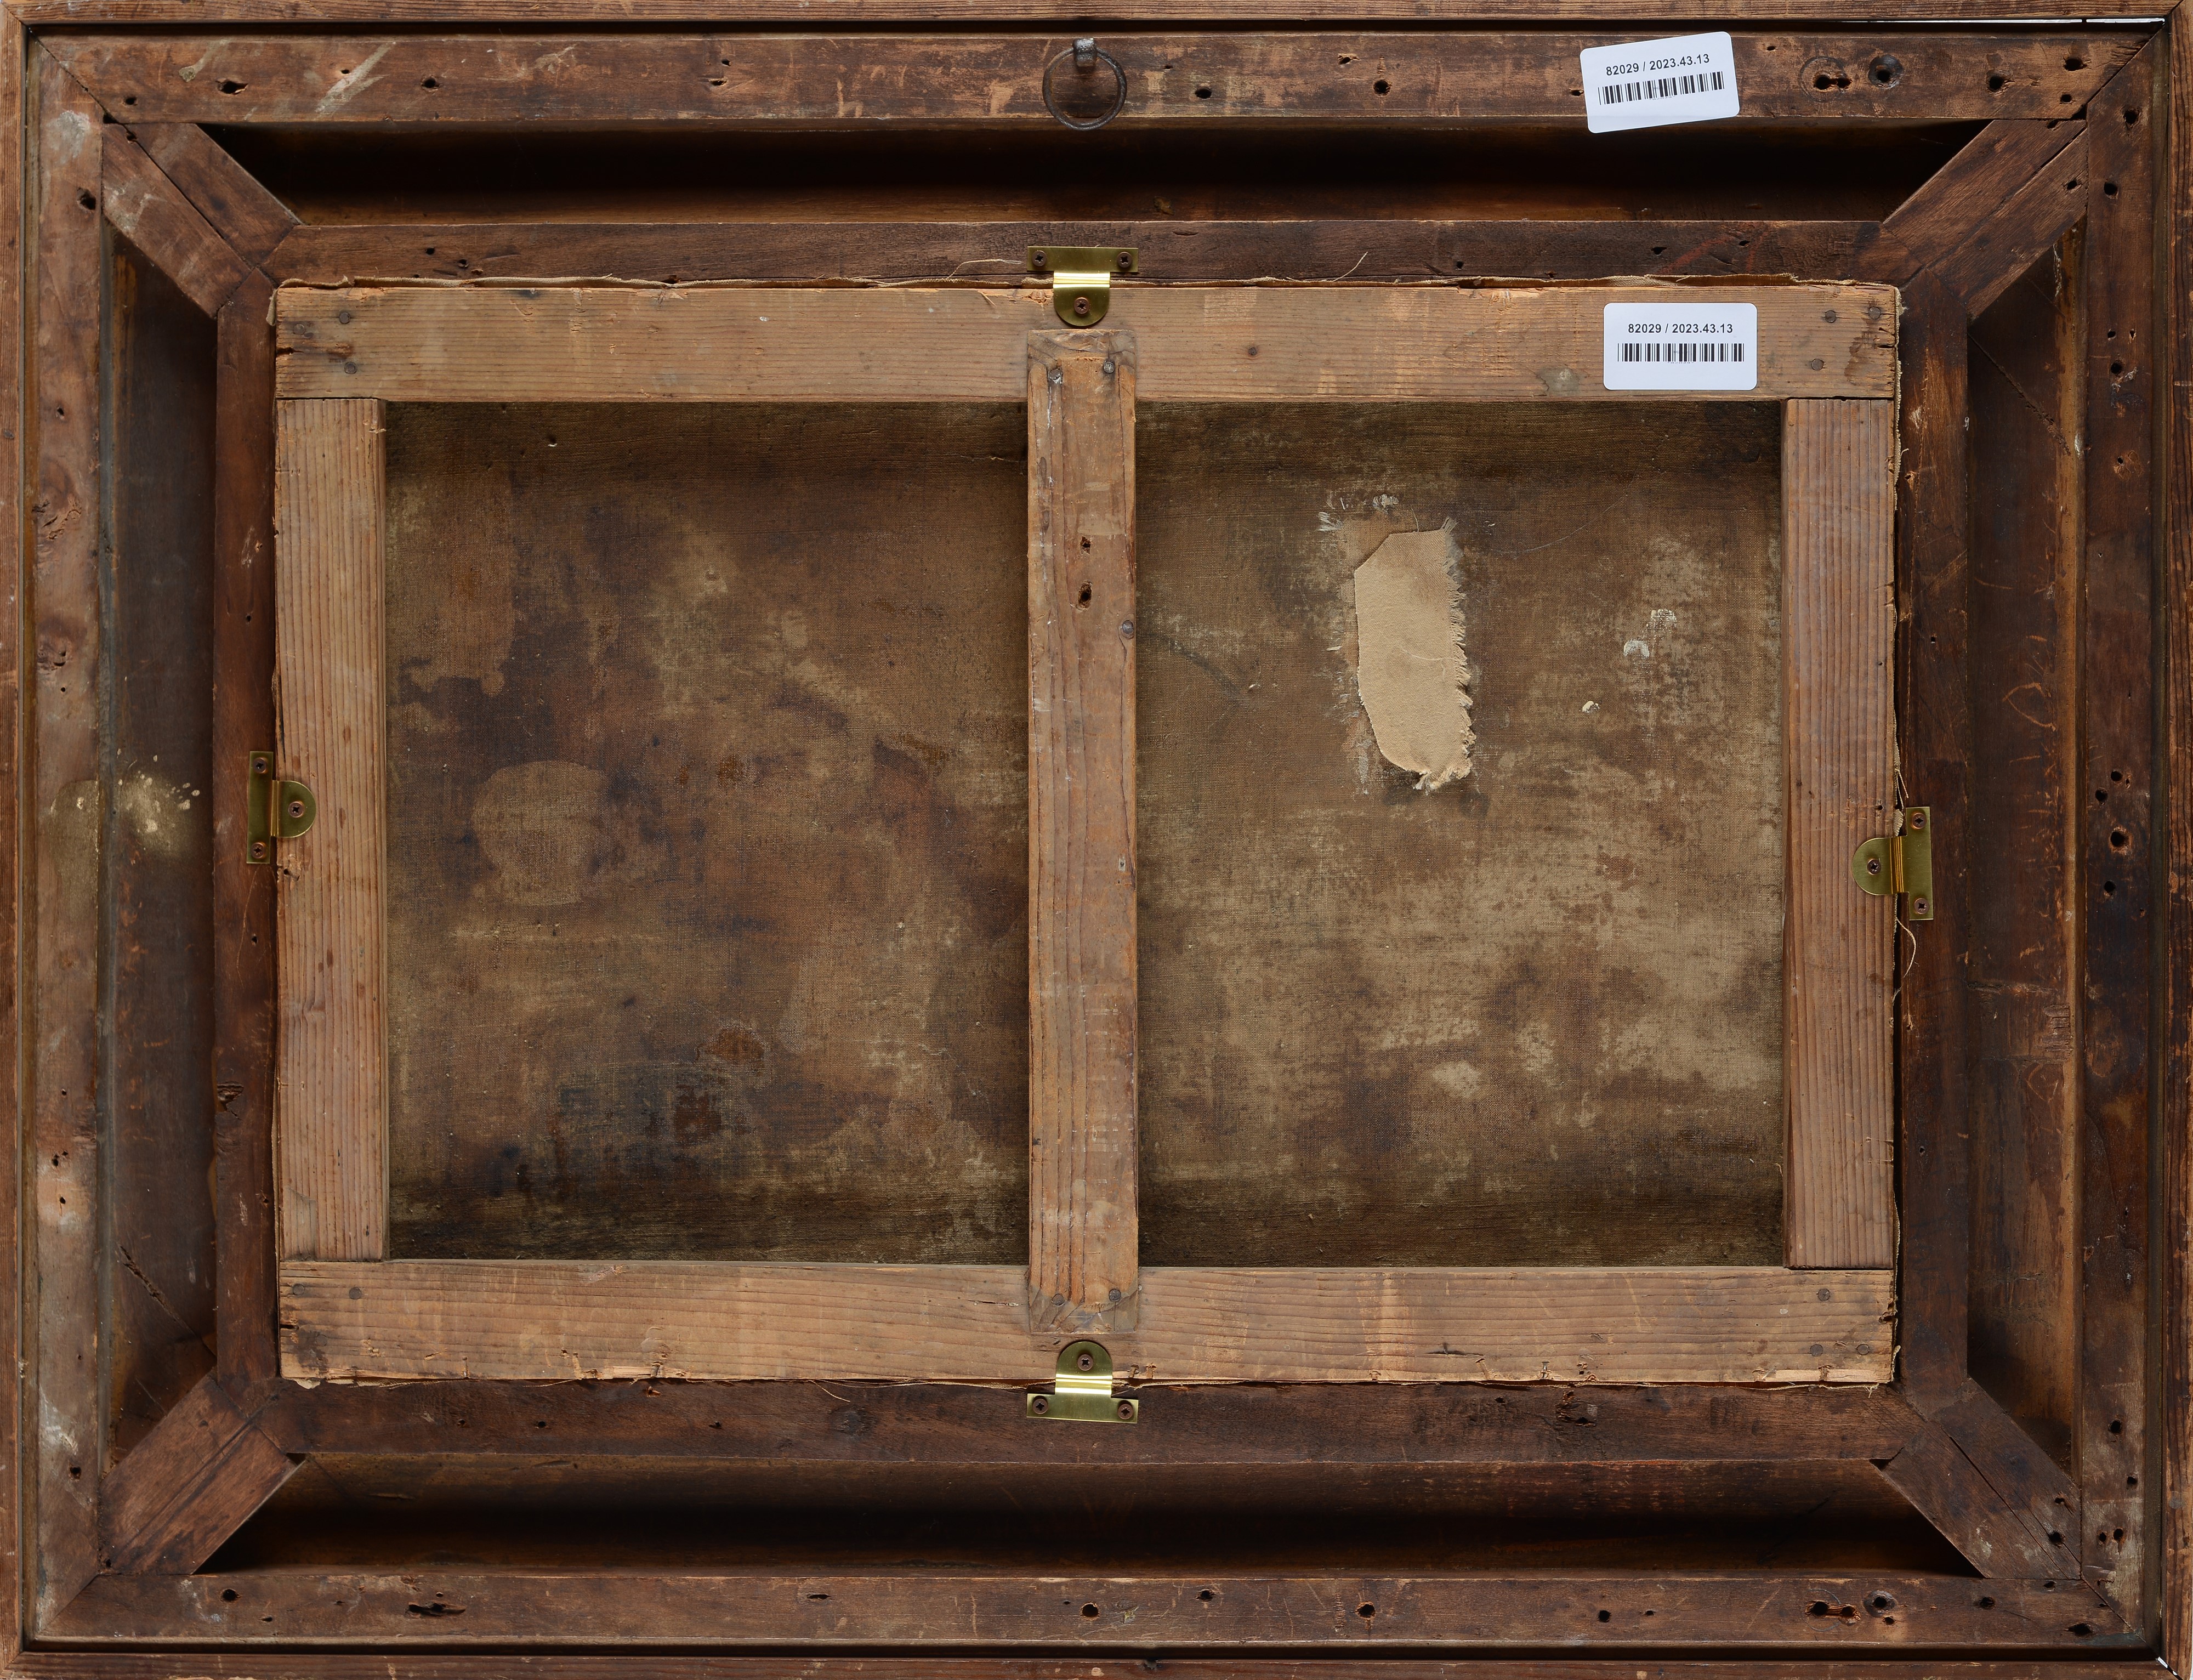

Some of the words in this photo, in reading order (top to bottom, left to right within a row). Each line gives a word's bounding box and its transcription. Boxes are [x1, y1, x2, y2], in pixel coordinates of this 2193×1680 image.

[1606, 63, 1639, 76] 82029
[1643, 61, 1646, 71] /
[1649, 54, 1709, 71] 2023.43.13
[1628, 323, 1661, 333] 82029
[1665, 323, 1669, 333] /
[1672, 323, 1733, 333] 2023.43.13
